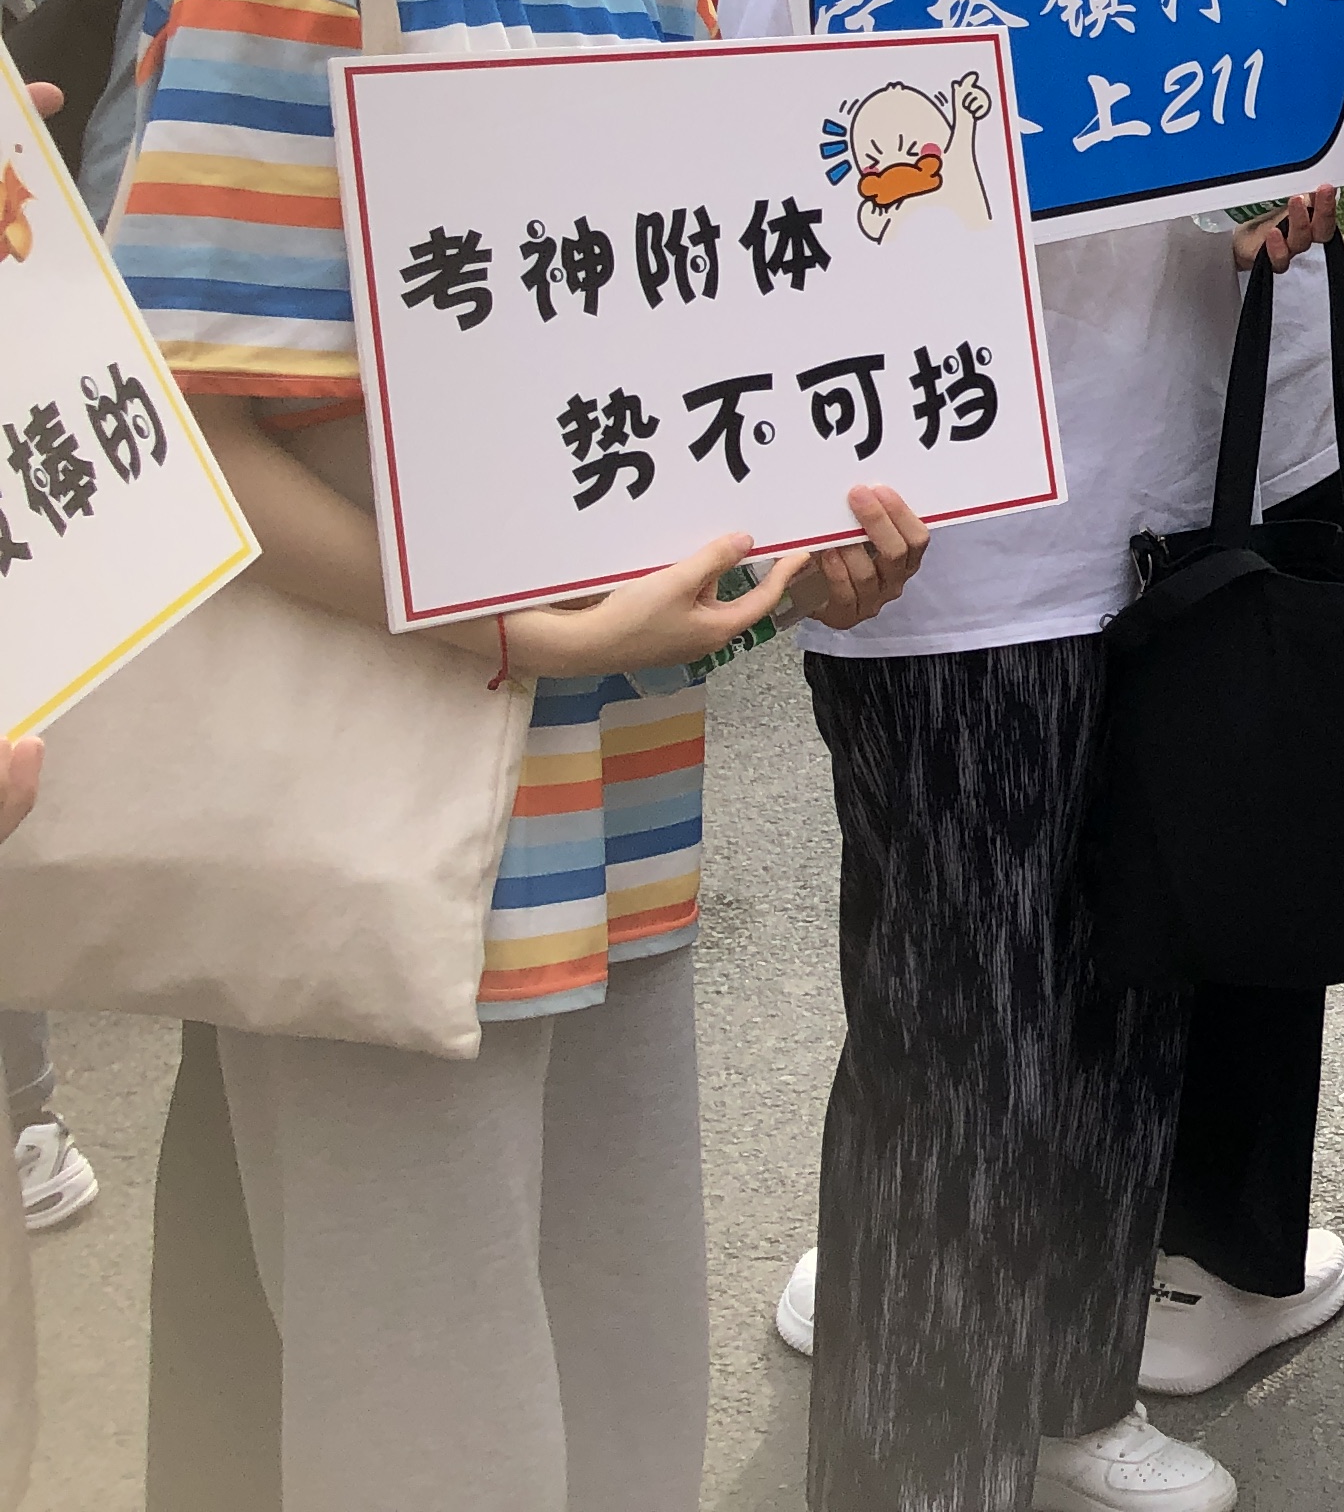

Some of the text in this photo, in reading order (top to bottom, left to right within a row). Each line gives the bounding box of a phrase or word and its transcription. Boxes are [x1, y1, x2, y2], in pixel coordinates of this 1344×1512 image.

[1018, 49, 1265, 153] 上211
[401, 196, 833, 331] 考神附体
[556, 339, 1000, 511] 势不可挡
